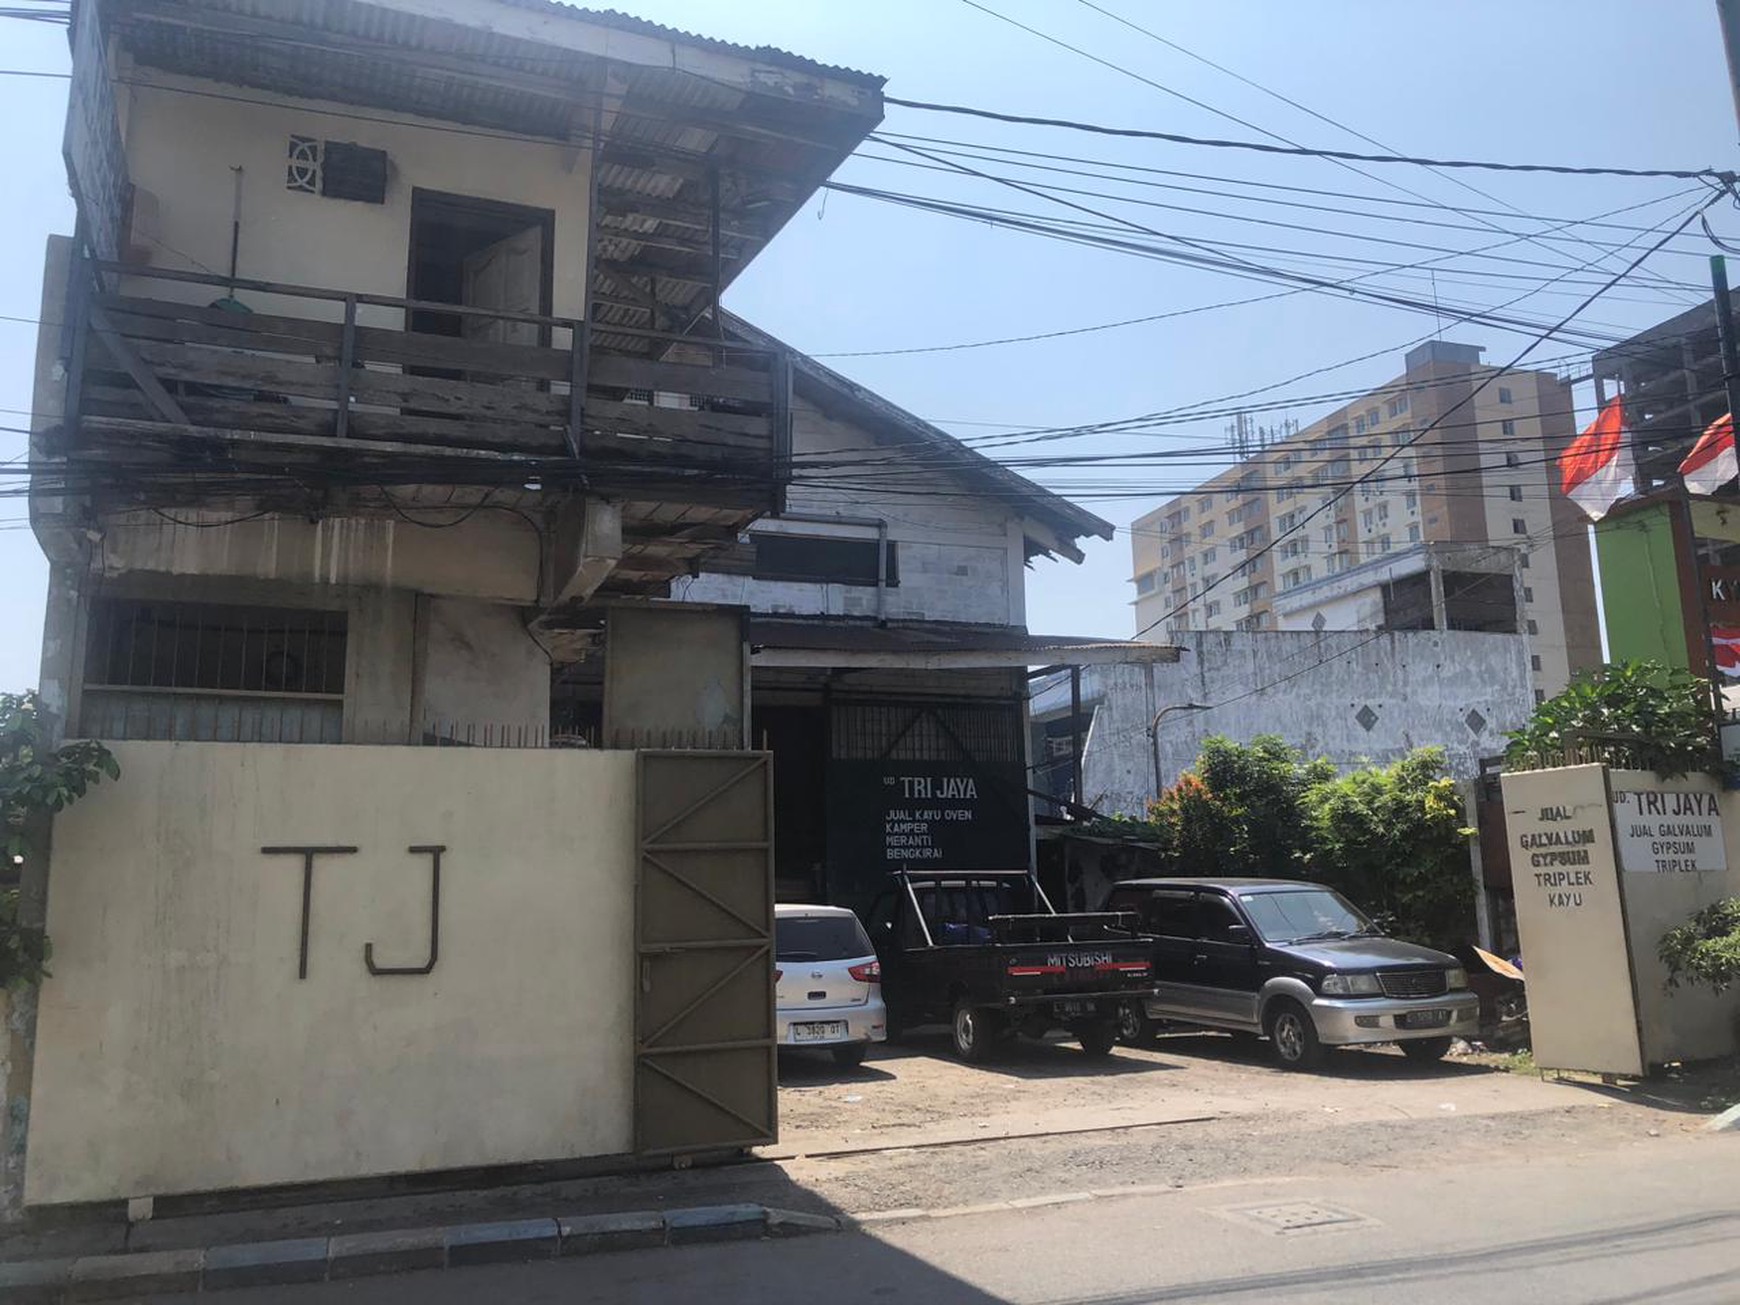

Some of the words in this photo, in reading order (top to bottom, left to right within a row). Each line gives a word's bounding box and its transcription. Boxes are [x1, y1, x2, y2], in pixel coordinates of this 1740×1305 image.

[900, 776, 932, 798] TRI
[935, 777, 978, 799] JAYA
[1633, 791, 1667, 816] TRI
[1672, 792, 1720, 816] JAYA
[885, 809, 913, 821] JUAL
[915, 809, 941, 821] KAYU
[944, 809, 972, 821] OVEN
[1538, 805, 1572, 821] JUAL
[885, 822, 928, 834] KAMPER
[1629, 823, 1655, 838] JUAL
[1659, 823, 1713, 838] GALVALUM
[885, 835, 932, 847] MERANTI
[1520, 828, 1596, 850] GALVALUM
[886, 848, 943, 860] BENGKIRAI
[1651, 841, 1696, 855] GYPSUM
[1531, 849, 1591, 868] GYPSUM
[1655, 859, 1698, 874] TRIPLEK
[1534, 870, 1593, 888] TRIPLEK
[1547, 892, 1583, 909] KAYU
[261, 844, 447, 979] TJ
[1047, 951, 1113, 968] MITSUBISHI
